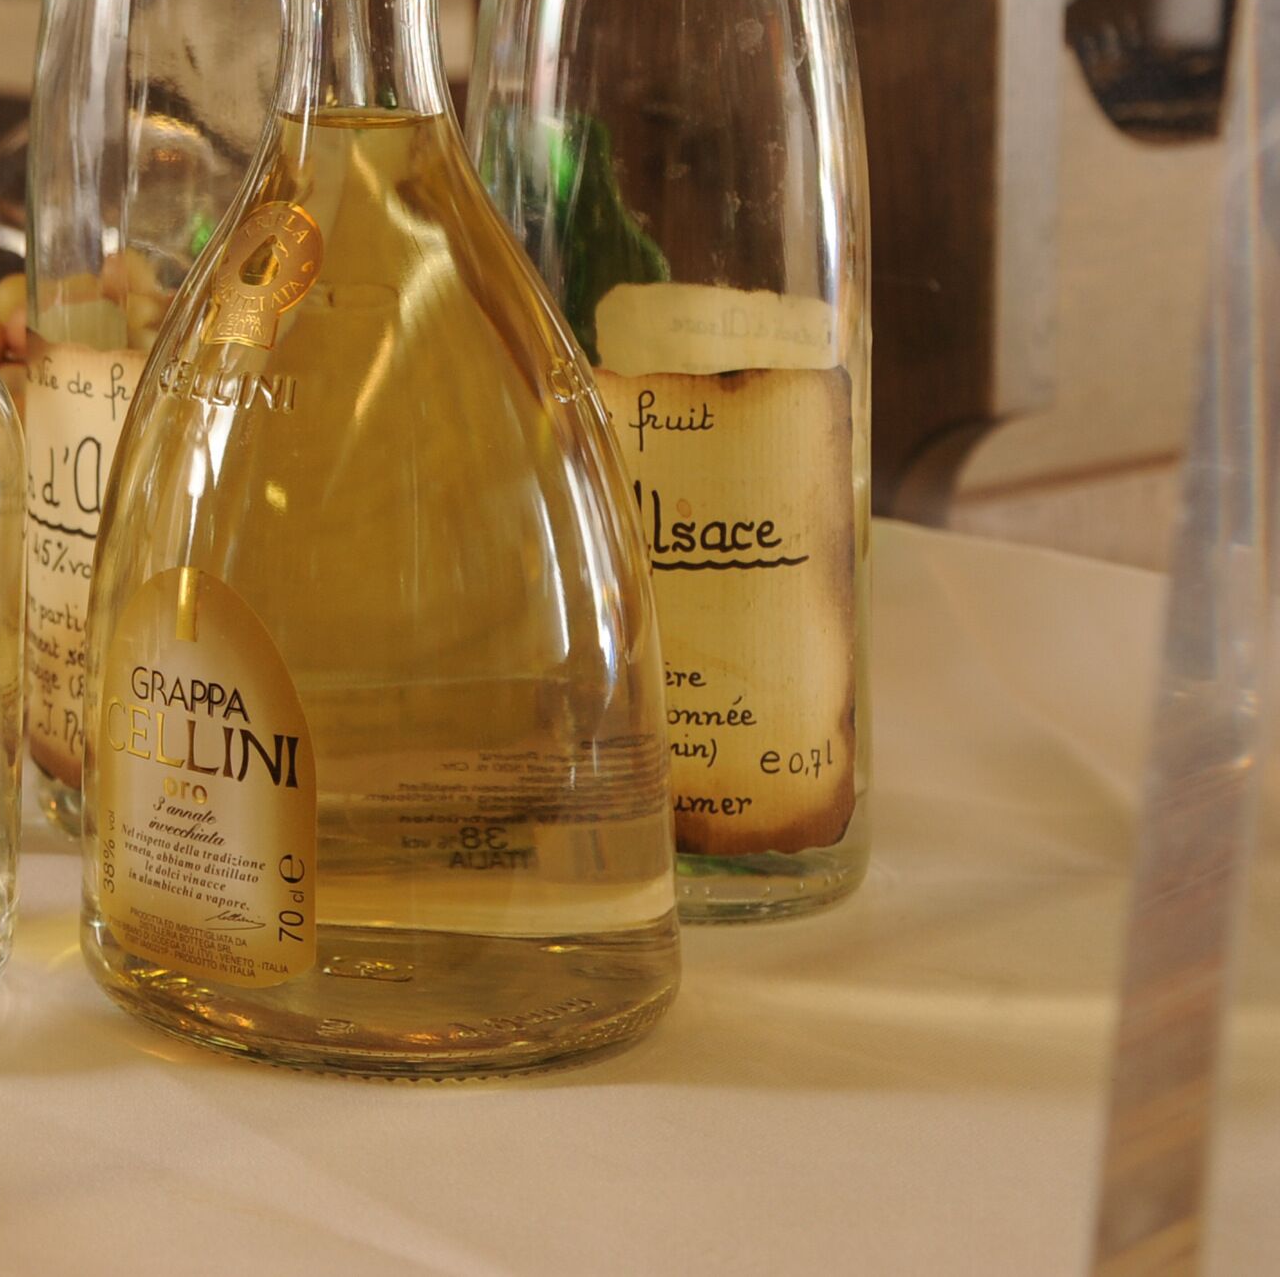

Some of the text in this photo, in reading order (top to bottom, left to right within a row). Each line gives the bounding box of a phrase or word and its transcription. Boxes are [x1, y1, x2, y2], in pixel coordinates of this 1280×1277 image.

[628, 389, 714, 452] fruit
[131, 666, 250, 724] GRAPPA
[107, 696, 299, 788] CELLINI
[153, 796, 165, 812] 3
[163, 776, 208, 804] oro
[148, 816, 225, 846] invecchiata
[121, 824, 266, 871] Nel rispetto della tradizione
[124, 841, 259, 884] veneta, abbiamo distillato
[145, 860, 226, 892] le dolci vinacce
[139, 873, 194, 899] alambicchi
[196, 891, 202, 901] a
[206, 894, 250, 912] vapore.
[289, 890, 304, 903] cl
[235, 937, 248, 947] DA
[279, 910, 304, 942] 70
[220, 953, 254, 969] VENETO
[262, 962, 289, 974] ITALIA
[230, 964, 256, 977] ITALIA
